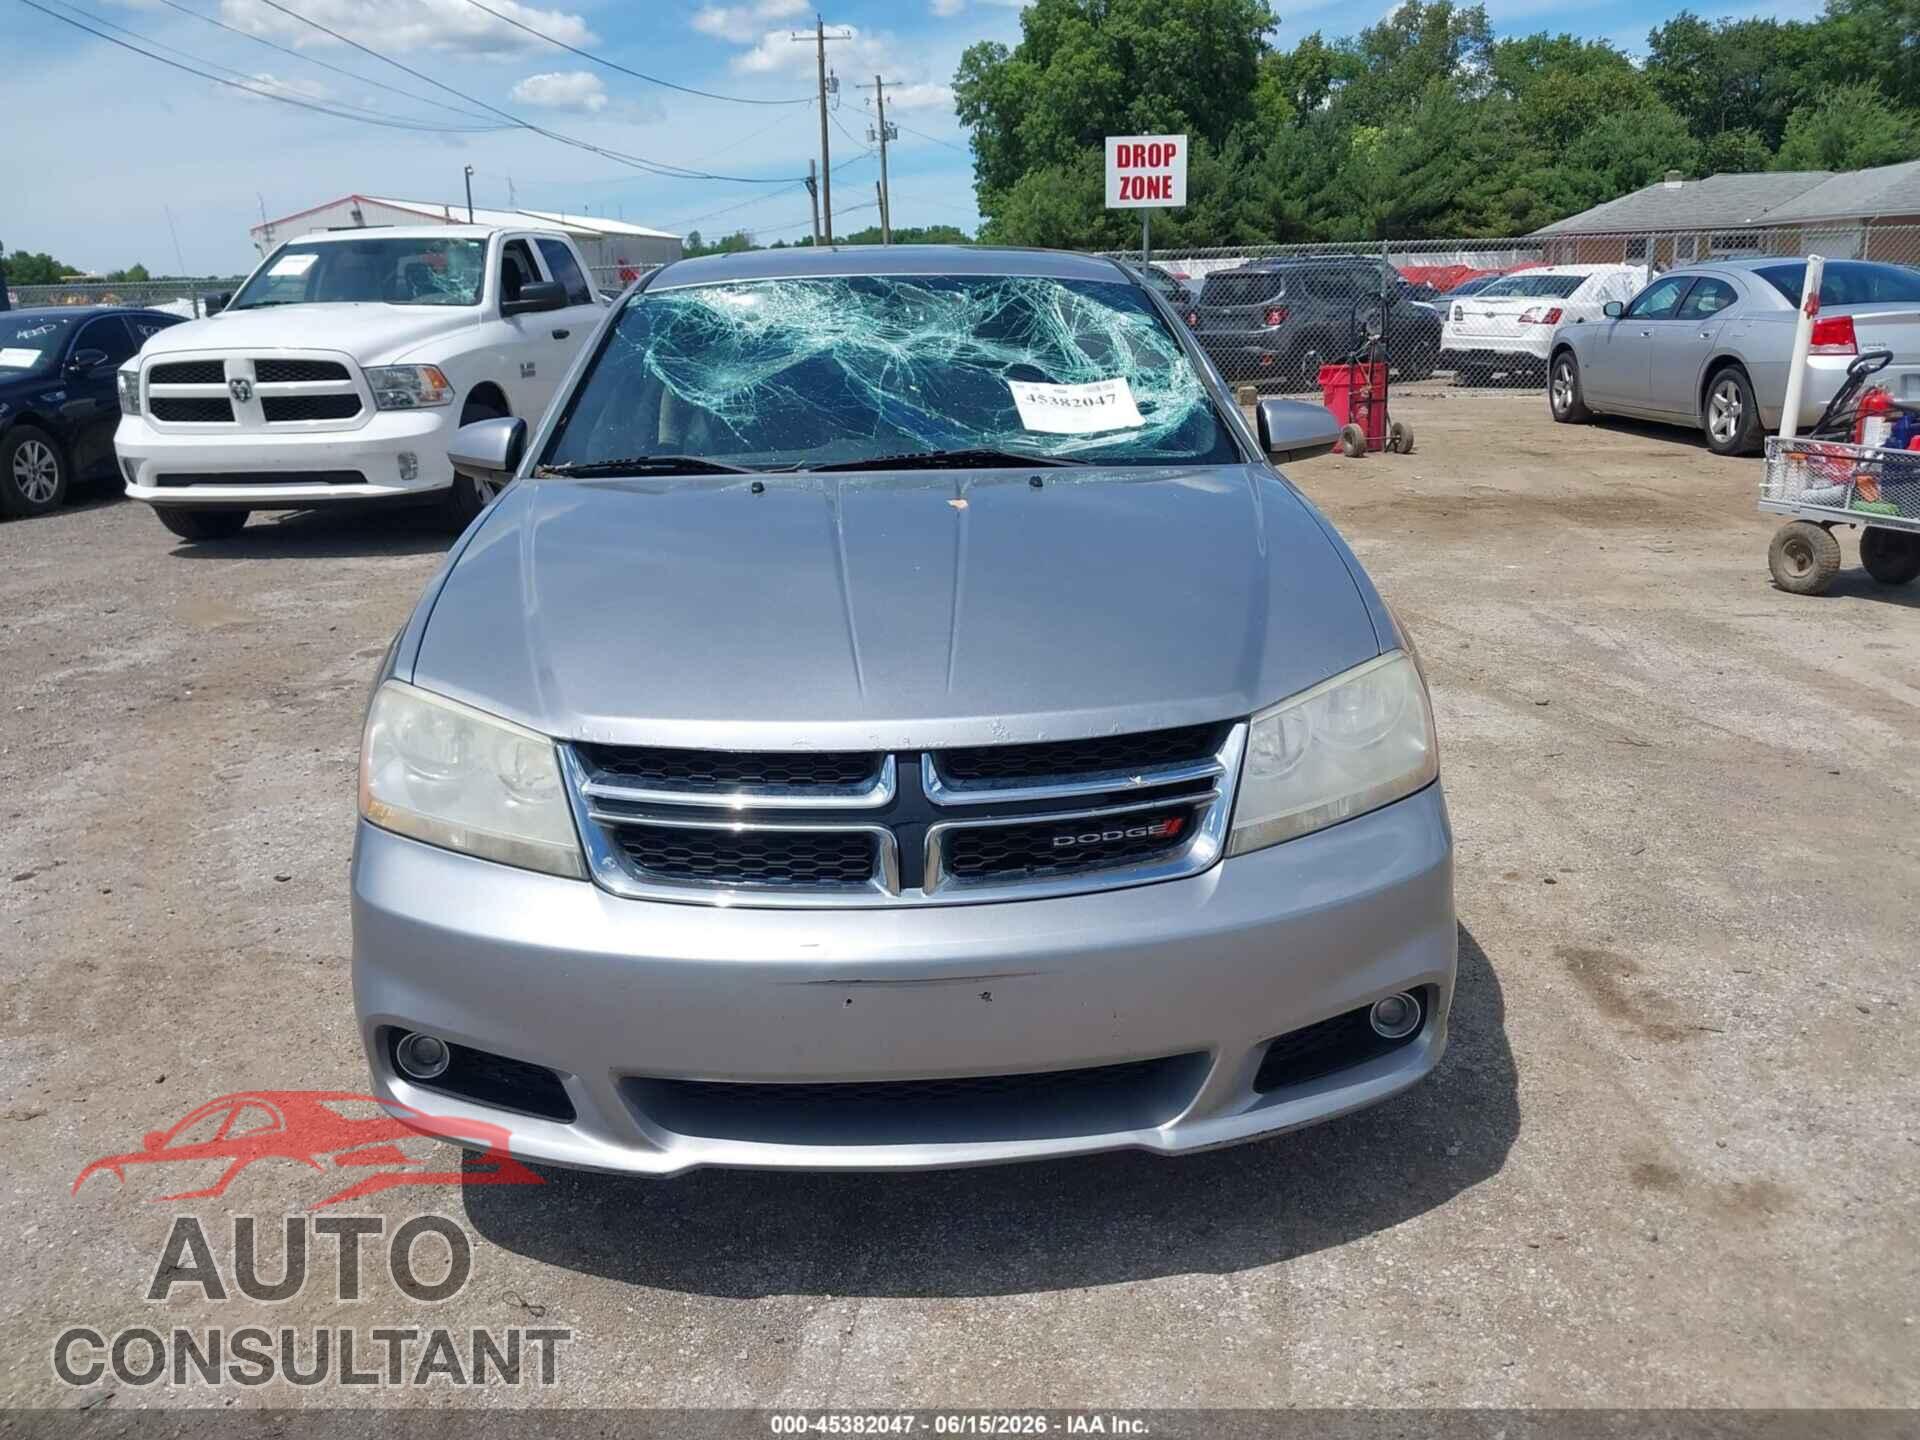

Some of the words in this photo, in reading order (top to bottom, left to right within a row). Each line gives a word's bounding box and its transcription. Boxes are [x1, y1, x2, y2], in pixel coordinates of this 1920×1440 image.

[1117, 143, 1177, 168] DROP
[1119, 175, 1173, 201] ZONE
[1026, 393, 1117, 408] 45382047
[1053, 824, 1168, 846] DODGE
